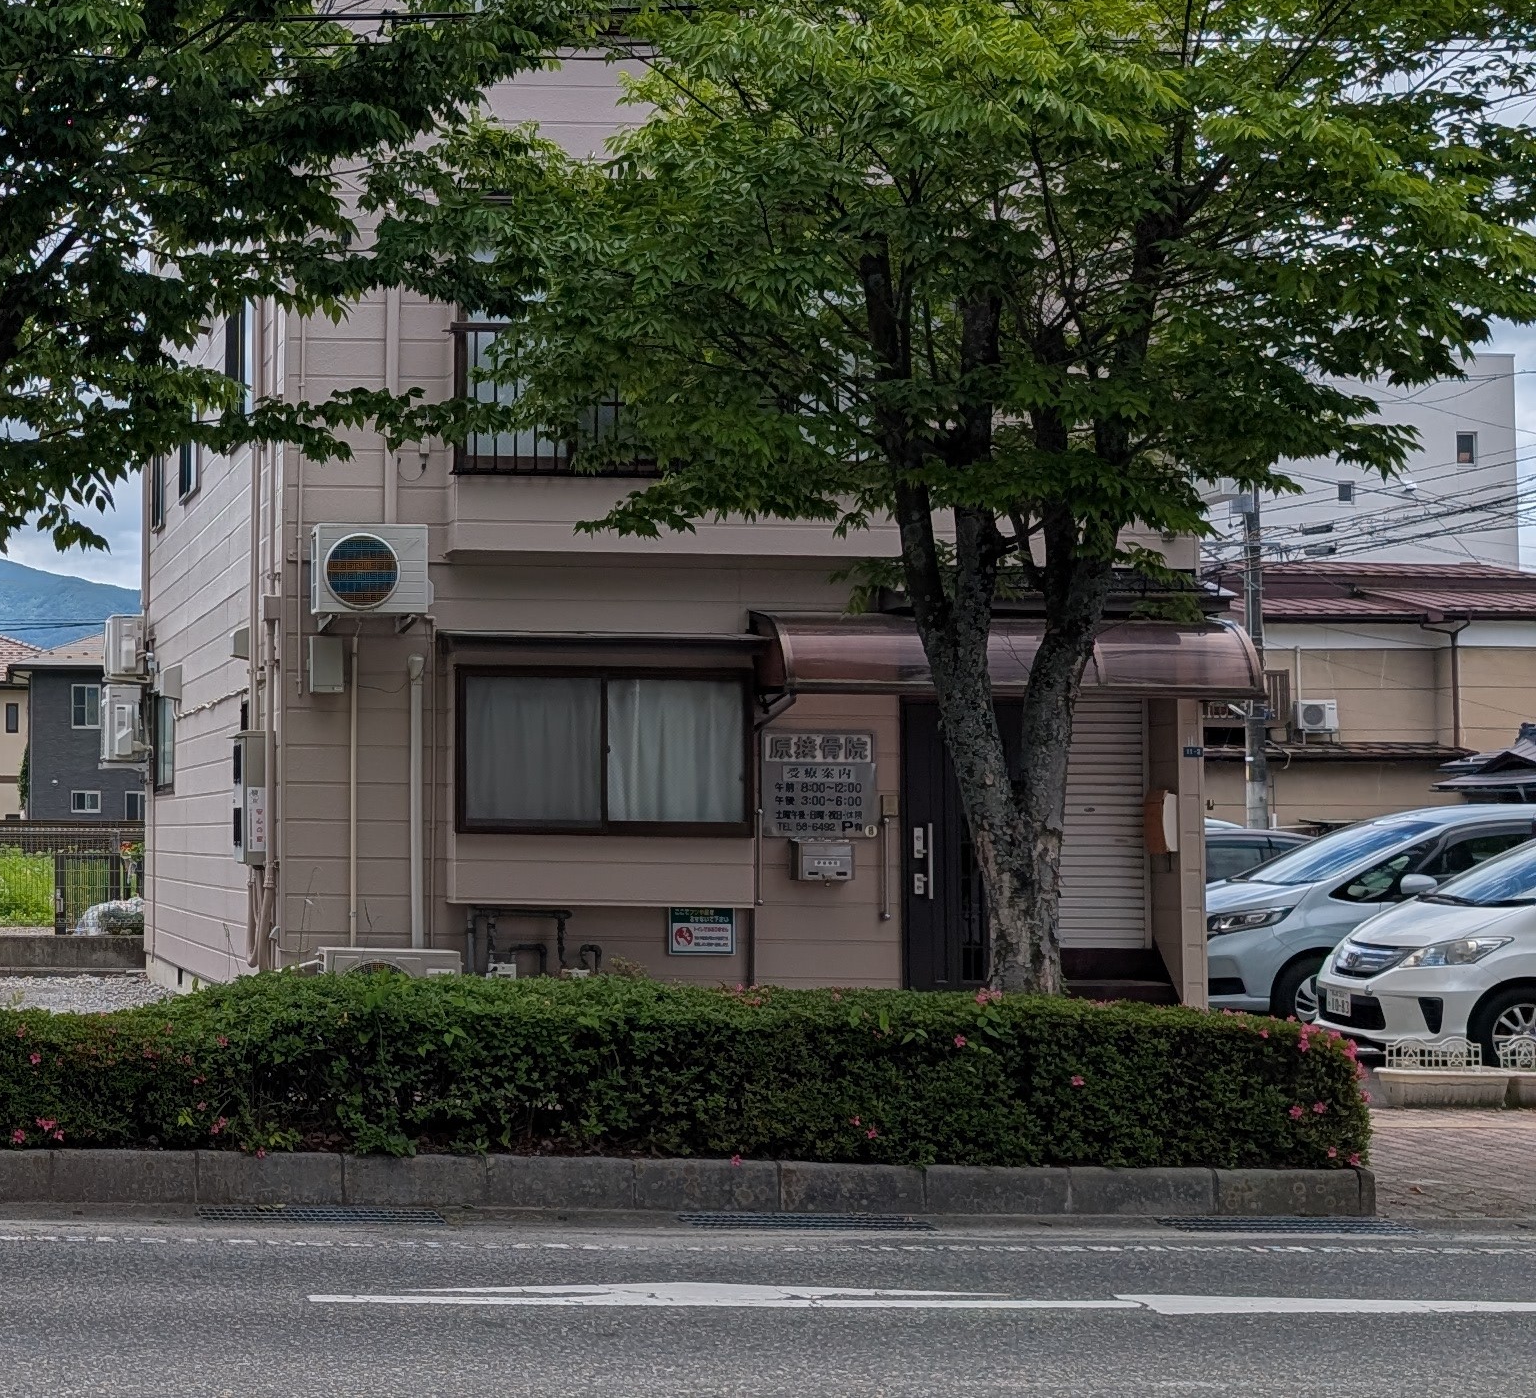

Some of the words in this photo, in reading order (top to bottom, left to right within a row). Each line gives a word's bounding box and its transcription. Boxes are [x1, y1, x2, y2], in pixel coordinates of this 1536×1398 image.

[769, 735, 869, 760] 原接骨院
[774, 782, 795, 793] 午前
[774, 795, 795, 806] 午後
[777, 822, 793, 832] TEL
[795, 821, 836, 832] 58-6492
